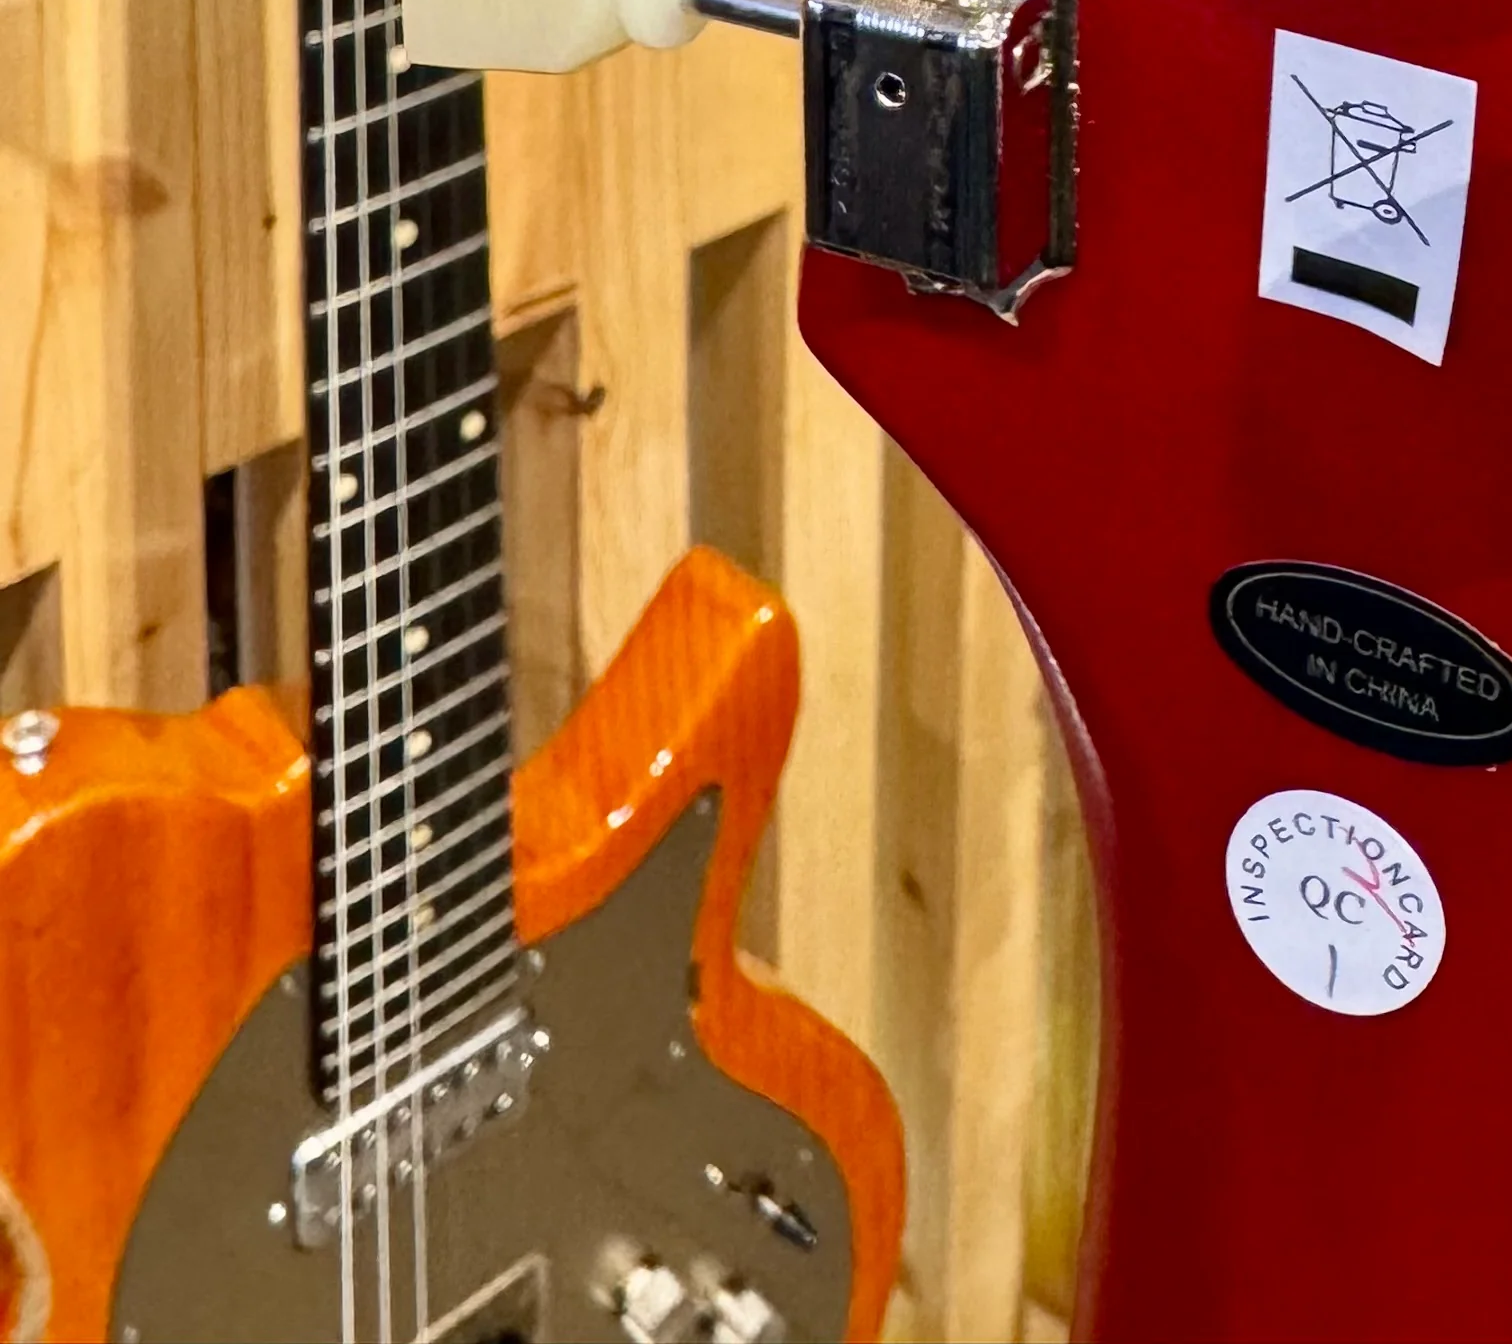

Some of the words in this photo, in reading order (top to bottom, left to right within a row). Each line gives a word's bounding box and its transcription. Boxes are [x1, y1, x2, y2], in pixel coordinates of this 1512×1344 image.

[1255, 594, 1501, 702] HAND-CRAFTED
[1307, 654, 1338, 685] IN
[1345, 671, 1440, 723] CHINA
[1299, 874, 1366, 925] QC
